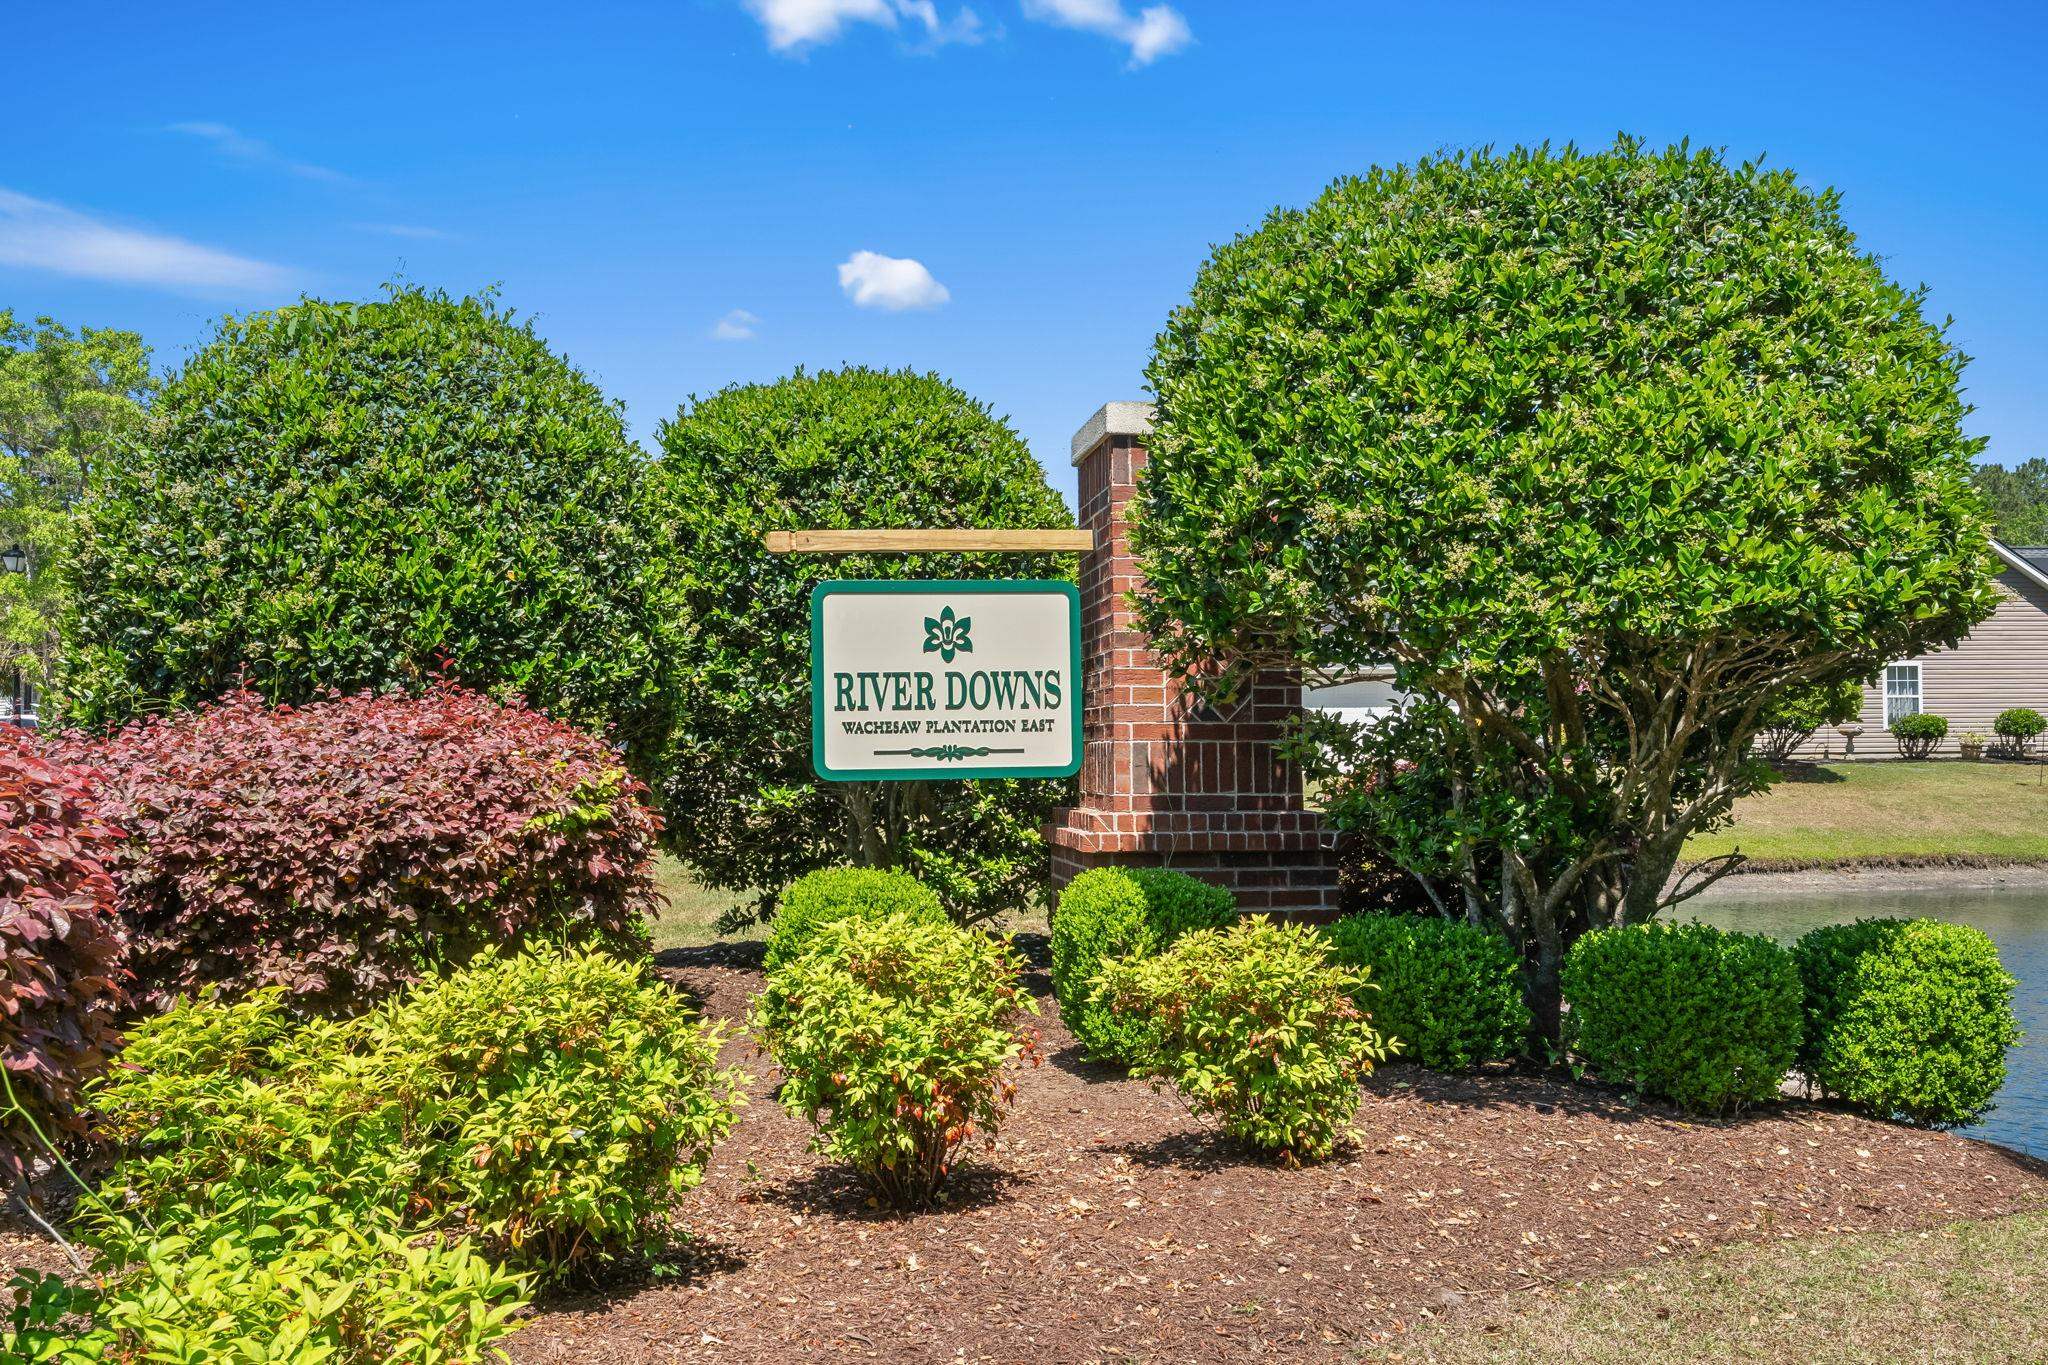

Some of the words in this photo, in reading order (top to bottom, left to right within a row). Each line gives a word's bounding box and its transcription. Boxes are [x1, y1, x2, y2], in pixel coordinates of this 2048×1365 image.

[833, 671, 936, 712] RIVER
[944, 669, 1062, 711] DOWNS
[841, 720, 921, 735] WACHESAW
[925, 719, 1016, 734] PLANTATION
[1021, 718, 1055, 733] EAST
